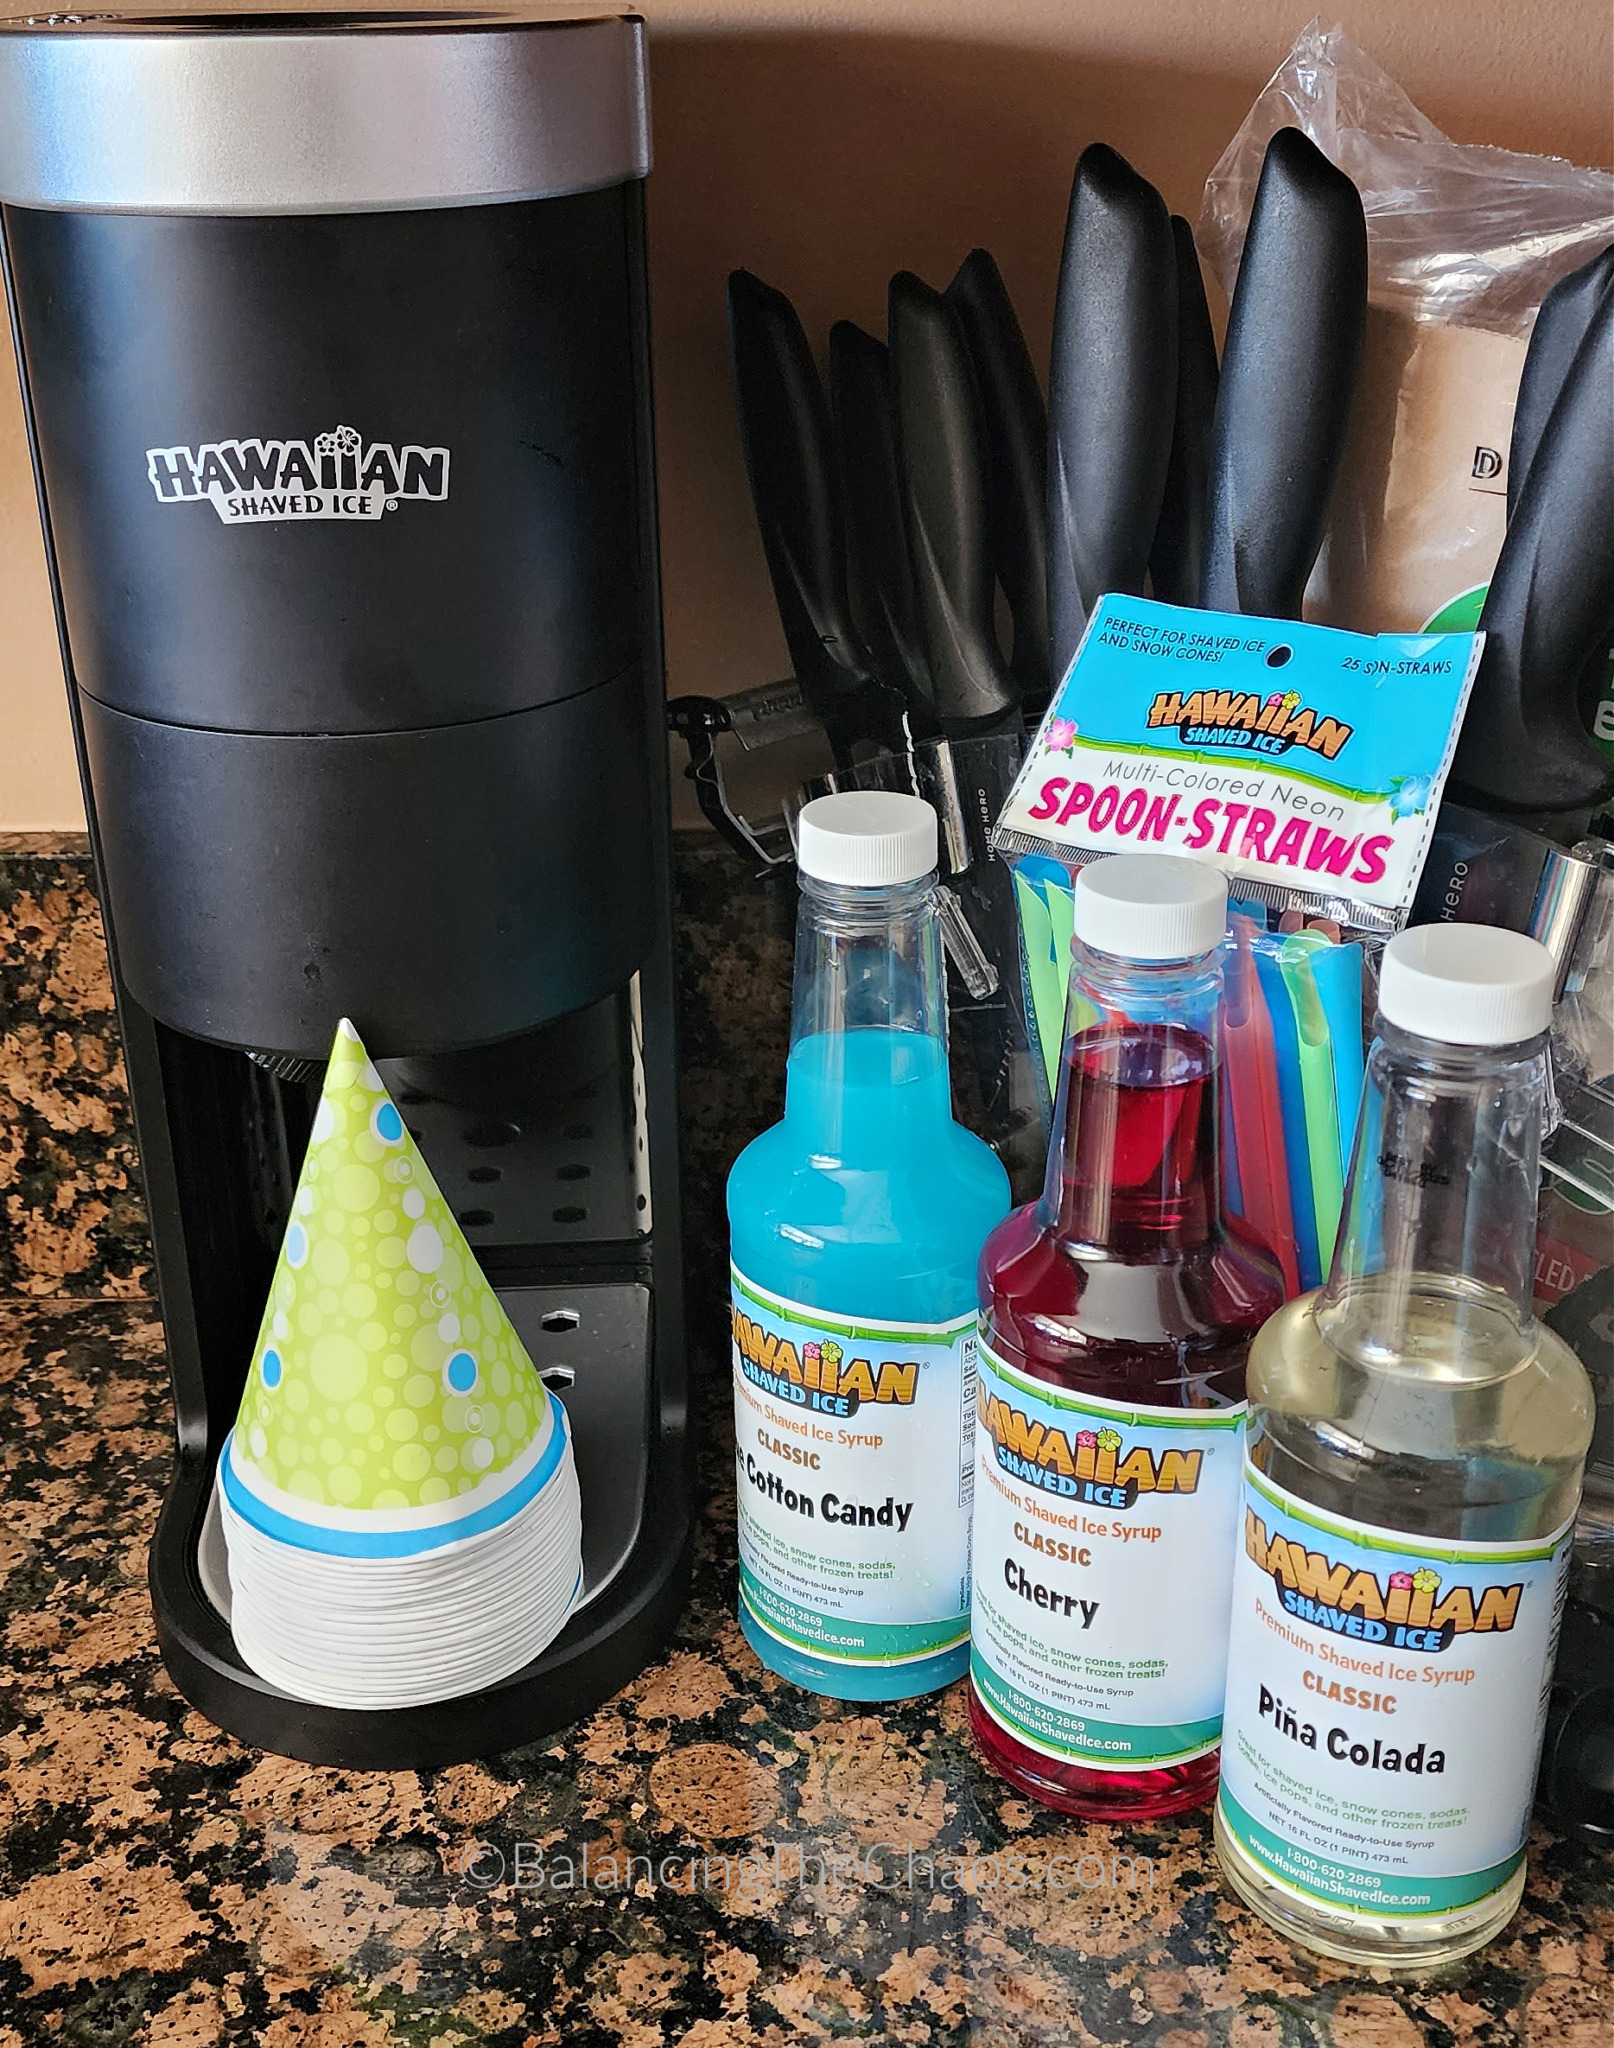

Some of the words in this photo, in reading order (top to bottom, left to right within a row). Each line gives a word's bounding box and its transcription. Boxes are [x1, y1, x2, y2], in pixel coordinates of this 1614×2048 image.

[148, 430, 449, 500] HAWAIIAN
[228, 495, 323, 516] SHAVED
[333, 494, 372, 514] ICE
[1098, 631, 1129, 648] AND
[1132, 639, 1174, 657] SNOW
[1175, 648, 1224, 662] CONES!
[1104, 617, 1159, 639] PERFECT
[1161, 629, 1187, 644] FOR
[1189, 633, 1240, 650] SHAVED
[1243, 640, 1266, 652] ICE
[1341, 657, 1361, 670] 25
[1148, 691, 1353, 760] HAWAIIAN
[1184, 726, 1252, 747] SHAVED
[1254, 736, 1284, 755] ICE
[1103, 760, 1264, 798] Multi-Colored
[1271, 784, 1345, 821] Neon
[1028, 776, 1395, 884] SPOON-STRAWS
[731, 1308, 920, 1406] AWAIIAN
[743, 1357, 806, 1404] SHAVED
[812, 1391, 850, 1417] ICE
[757, 1428, 821, 1471] CLASSIC
[765, 1402, 808, 1436] Shaved
[811, 1423, 834, 1443] Ice
[838, 1430, 883, 1449] Syrup
[746, 1453, 815, 1519] Cotton
[820, 1493, 914, 1533] Candy
[981, 1454, 1022, 1508] Premium
[1024, 1498, 1078, 1528] Shaved
[1082, 1518, 1107, 1536] Ice
[1112, 1522, 1162, 1544] Syrup
[998, 1446, 1077, 1496] SHAVED
[1084, 1482, 1127, 1508] ICE
[773, 1545, 789, 1561] and
[791, 1555, 817, 1571] other
[820, 1564, 854, 1579] frozen
[857, 1570, 893, 1579] treats!
[790, 1545, 816, 1562] snow
[819, 1555, 855, 1570] cones,
[858, 1561, 896, 1570] sodas,
[1014, 1521, 1092, 1566] CLASSIC
[1245, 1504, 1524, 1634] HAWAIIAN
[773, 1577, 783, 1588] OZ
[814, 1596, 828, 1605] 473
[830, 1600, 843, 1608] mL
[787, 1569, 837, 1593] Ready-to-Use
[838, 1586, 864, 1596] Syrup
[1004, 1558, 1100, 1630] Cherry
[998, 1613, 1027, 1641] shaved
[1029, 1635, 1047, 1653] ice,
[1050, 1647, 1082, 1662] snow
[1084, 1657, 1125, 1669] cones,
[1128, 1658, 1169, 1669] sodas,
[1255, 1598, 1315, 1656] Premium
[1318, 1643, 1384, 1678] Shaved
[1389, 1663, 1417, 1682] Ice
[1422, 1666, 1475, 1688] Syrup
[1283, 1589, 1387, 1643] SHAVED
[1394, 1626, 1443, 1651] ICE
[1003, 1629, 1027, 1653] pops,
[1029, 1647, 1048, 1662] and
[1051, 1657, 1082, 1672] other
[1085, 1665, 1124, 1679] frozen
[1127, 1667, 1165, 1678] treats!
[1012, 1655, 1043, 1677] Flavored
[1045, 1672, 1104, 1694] Ready-to-Use
[1107, 1687, 1134, 1697] Syrup
[1008, 1688, 1086, 1731] 1-800-620-2869
[1017, 1674, 1027, 1685] FL
[1029, 1680, 1040, 1691] OZ
[1041, 1686, 1049, 1697] (1
[1051, 1690, 1075, 1705] PINT)
[1077, 1698, 1093, 1709] 473
[1096, 1702, 1111, 1711] mL
[1302, 1669, 1398, 1715] CLASSIC
[1258, 1683, 1317, 1750] Piña
[1327, 1728, 1446, 1775] Colada
[1254, 1782, 1292, 1815] Artificially
[1293, 1810, 1333, 1834] Flavored
[1335, 1828, 1403, 1849] Ready-to-Use
[1405, 1839, 1434, 1849] Syrup
[1263, 1769, 1278, 1787] ice
[1314, 1802, 1338, 1817] and
[1342, 1811, 1377, 1826] other
[1381, 1817, 1423, 1830] frozen
[1427, 1816, 1467, 1829] treats!
[1273, 1766, 1312, 1796] shaved
[1341, 1799, 1377, 1815] snow
[1381, 1808, 1426, 1821] cones,
[1268, 1811, 1285, 1827] NET
[1287, 1823, 1297, 1834] 16
[1299, 1830, 1311, 1841] FL
[1314, 1836, 1328, 1848] OZ
[1329, 1843, 1338, 1852] (1
[1342, 1846, 1369, 1861] PINT)
[1372, 1853, 1390, 1863] 473
[1393, 1856, 1408, 1864] mL
[1248, 1834, 1431, 1905] www.HawaiianShavedIce.com
[1286, 1847, 1382, 1888] 1-800-620-2869
